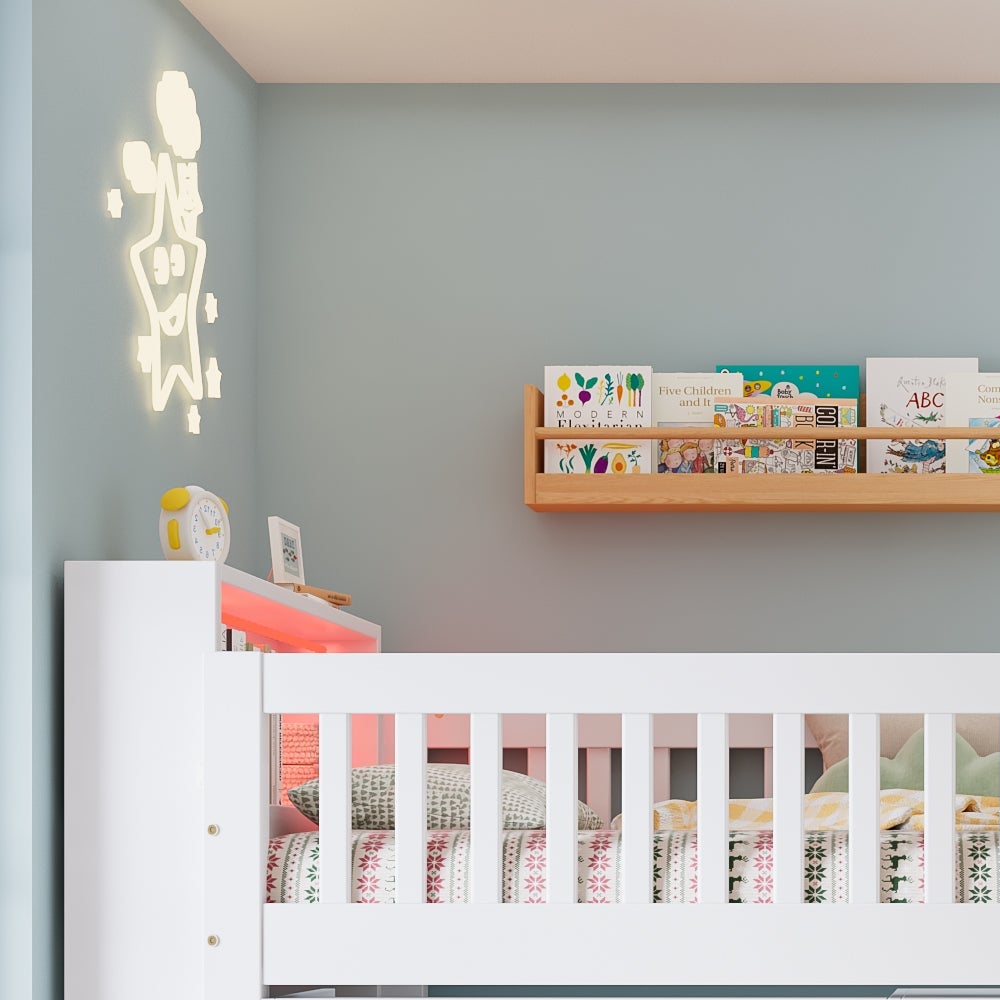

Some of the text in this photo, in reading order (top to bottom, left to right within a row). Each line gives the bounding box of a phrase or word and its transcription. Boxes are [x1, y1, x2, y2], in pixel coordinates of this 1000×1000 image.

[660, 386, 732, 396] Five Children
[680, 398, 712, 407] and It
[906, 392, 944, 409] ABC
